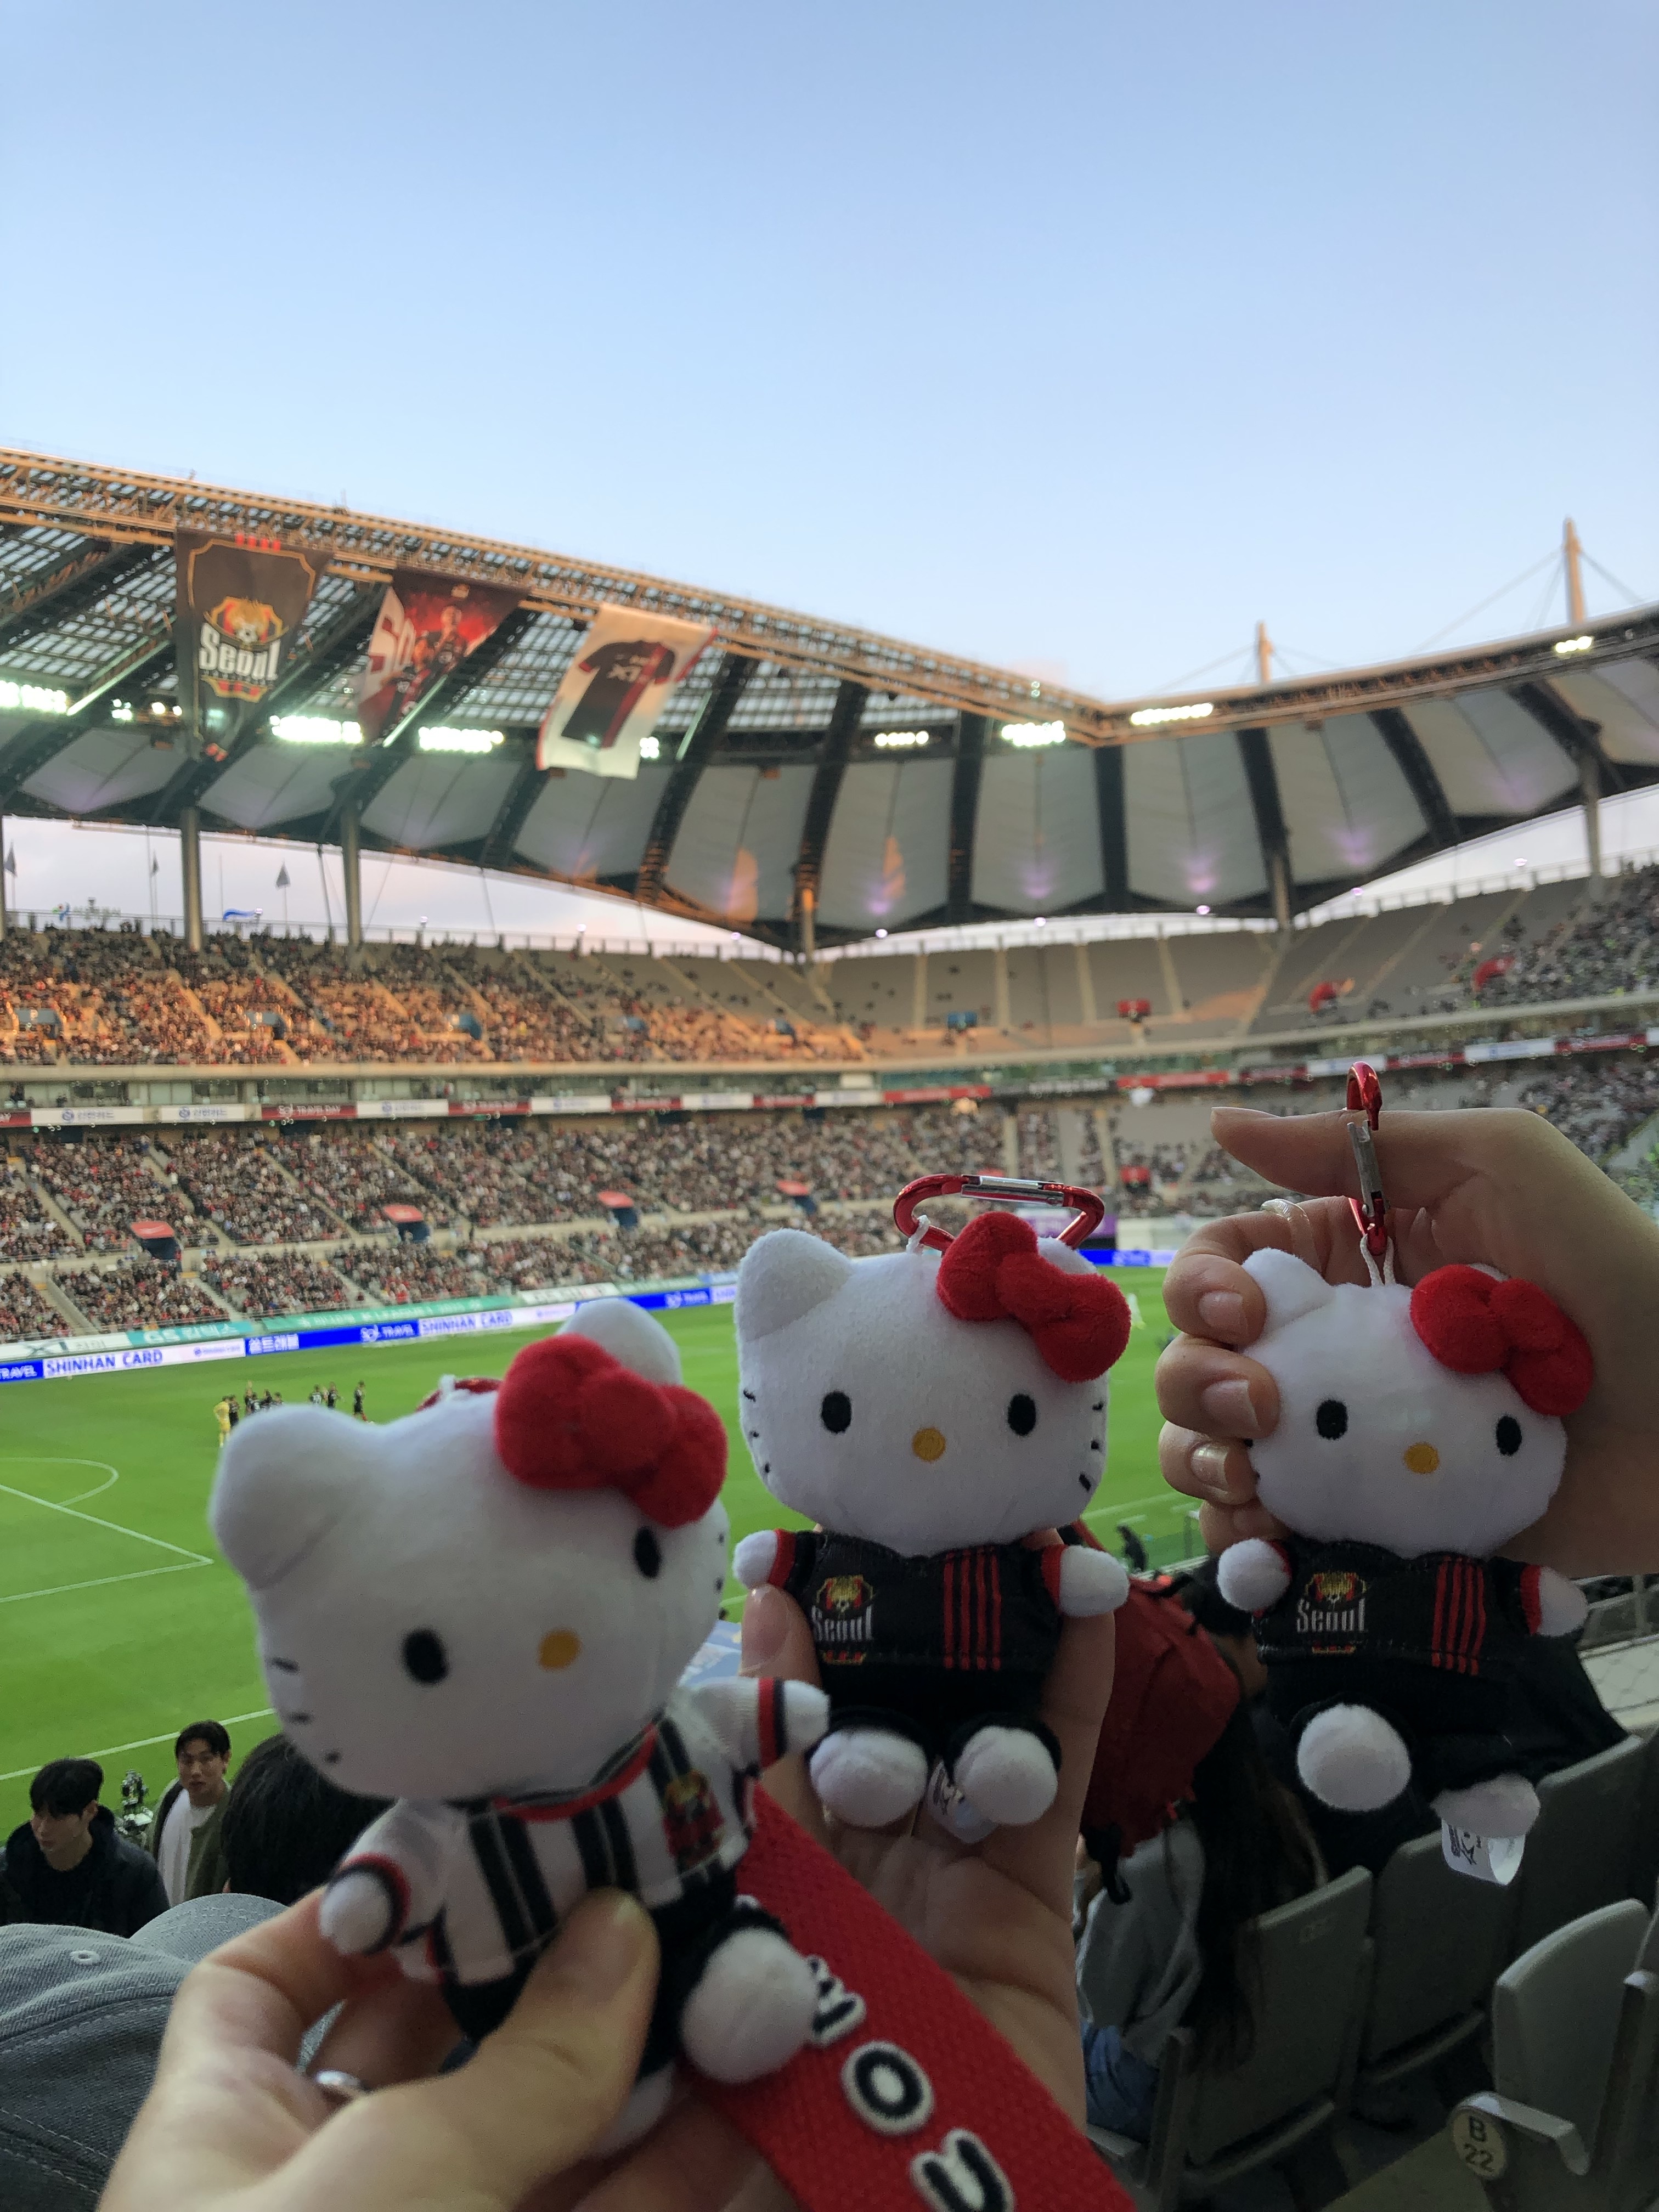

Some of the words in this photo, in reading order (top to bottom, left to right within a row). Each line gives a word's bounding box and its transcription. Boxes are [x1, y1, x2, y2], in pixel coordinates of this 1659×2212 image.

[199, 622, 281, 680] Seoul
[421, 1314, 476, 1333] SHINHAN
[47, 1355, 115, 1377] SHINHAN
[122, 1348, 163, 1370] CARD
[811, 1605, 874, 1642] Seoul
[1296, 1597, 1366, 1633] Seoul
[1469, 2115, 1487, 2142] B
[1464, 2142, 1494, 2172] 22
